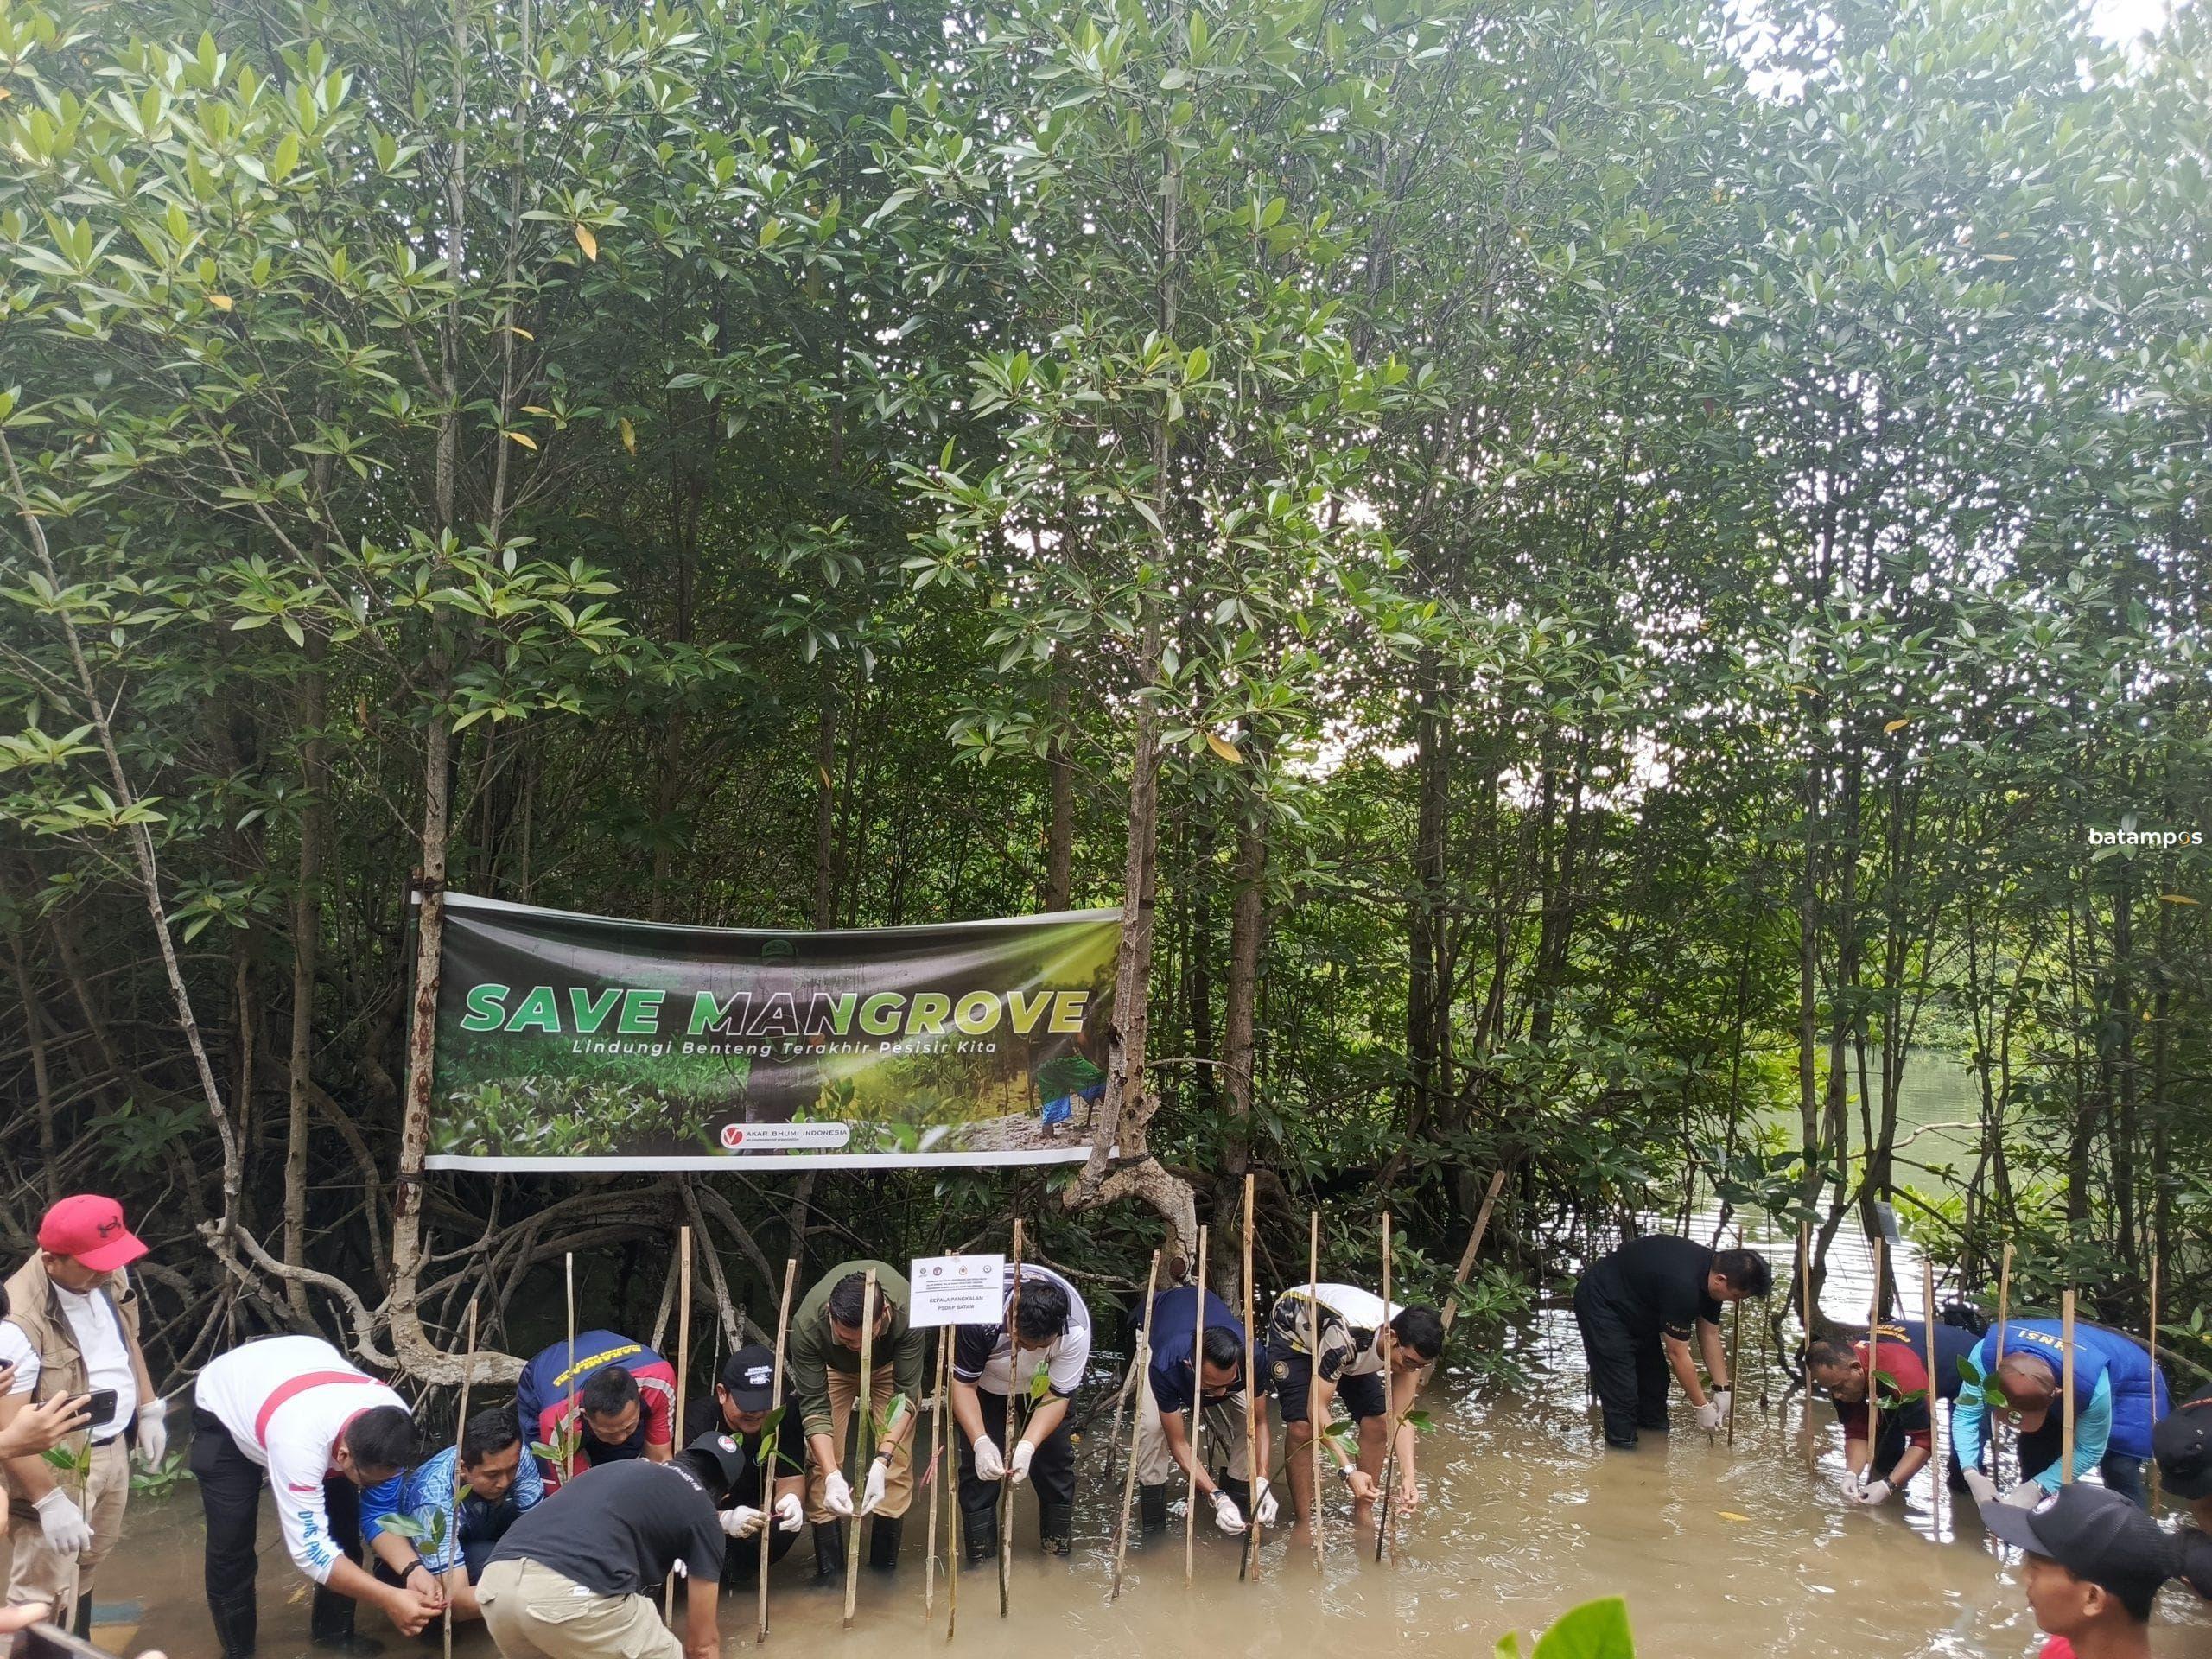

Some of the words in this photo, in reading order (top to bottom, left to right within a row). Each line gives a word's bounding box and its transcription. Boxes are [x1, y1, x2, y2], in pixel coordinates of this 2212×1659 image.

[460, 983, 666, 1035] SAVE
[687, 990, 1090, 1036] MANGROVE
[572, 1039, 672, 1057] Lindungi
[682, 1041, 772, 1058] Benteng
[784, 1041, 871, 1055] Terakhir
[880, 1040, 949, 1054] Pesisir
[957, 1039, 996, 1053] Kita
